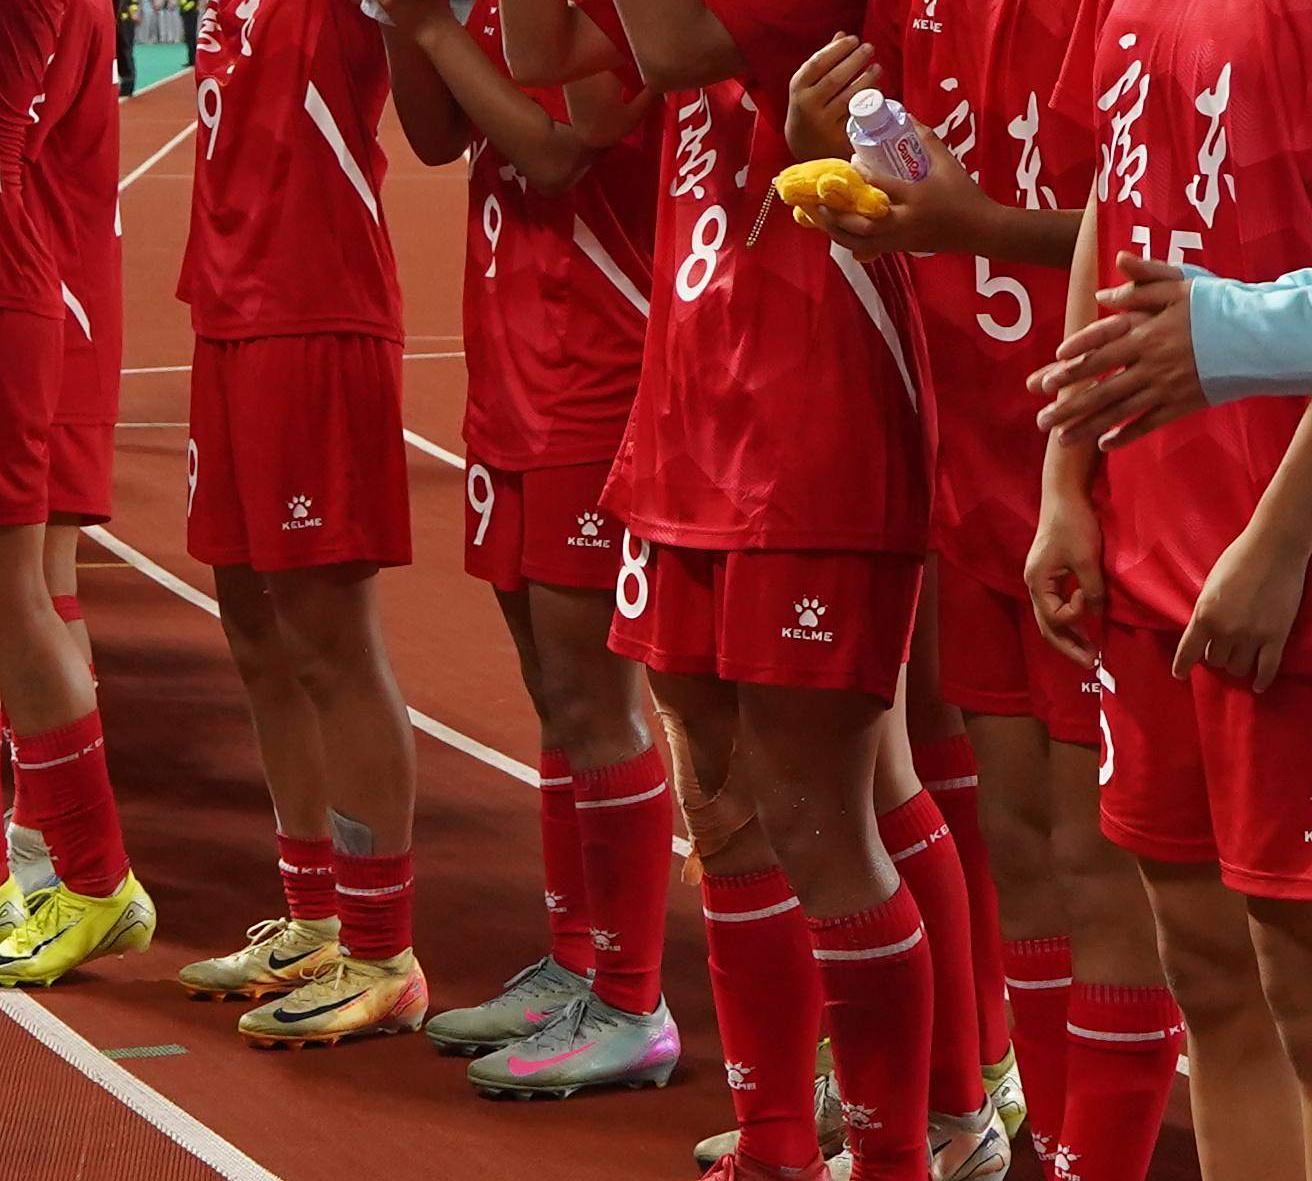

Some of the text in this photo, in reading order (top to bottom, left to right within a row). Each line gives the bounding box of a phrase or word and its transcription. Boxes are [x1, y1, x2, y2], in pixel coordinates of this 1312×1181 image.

[198, 77, 223, 160] 9
[483, 193, 503, 278] 9
[675, 204, 728, 302] 8
[975, 254, 1033, 343] 5
[282, 518, 323, 531] KELME
[468, 463, 495, 546] 9
[567, 536, 611, 549] KELME
[616, 526, 651, 619] 8
[781, 627, 834, 642] KELME
